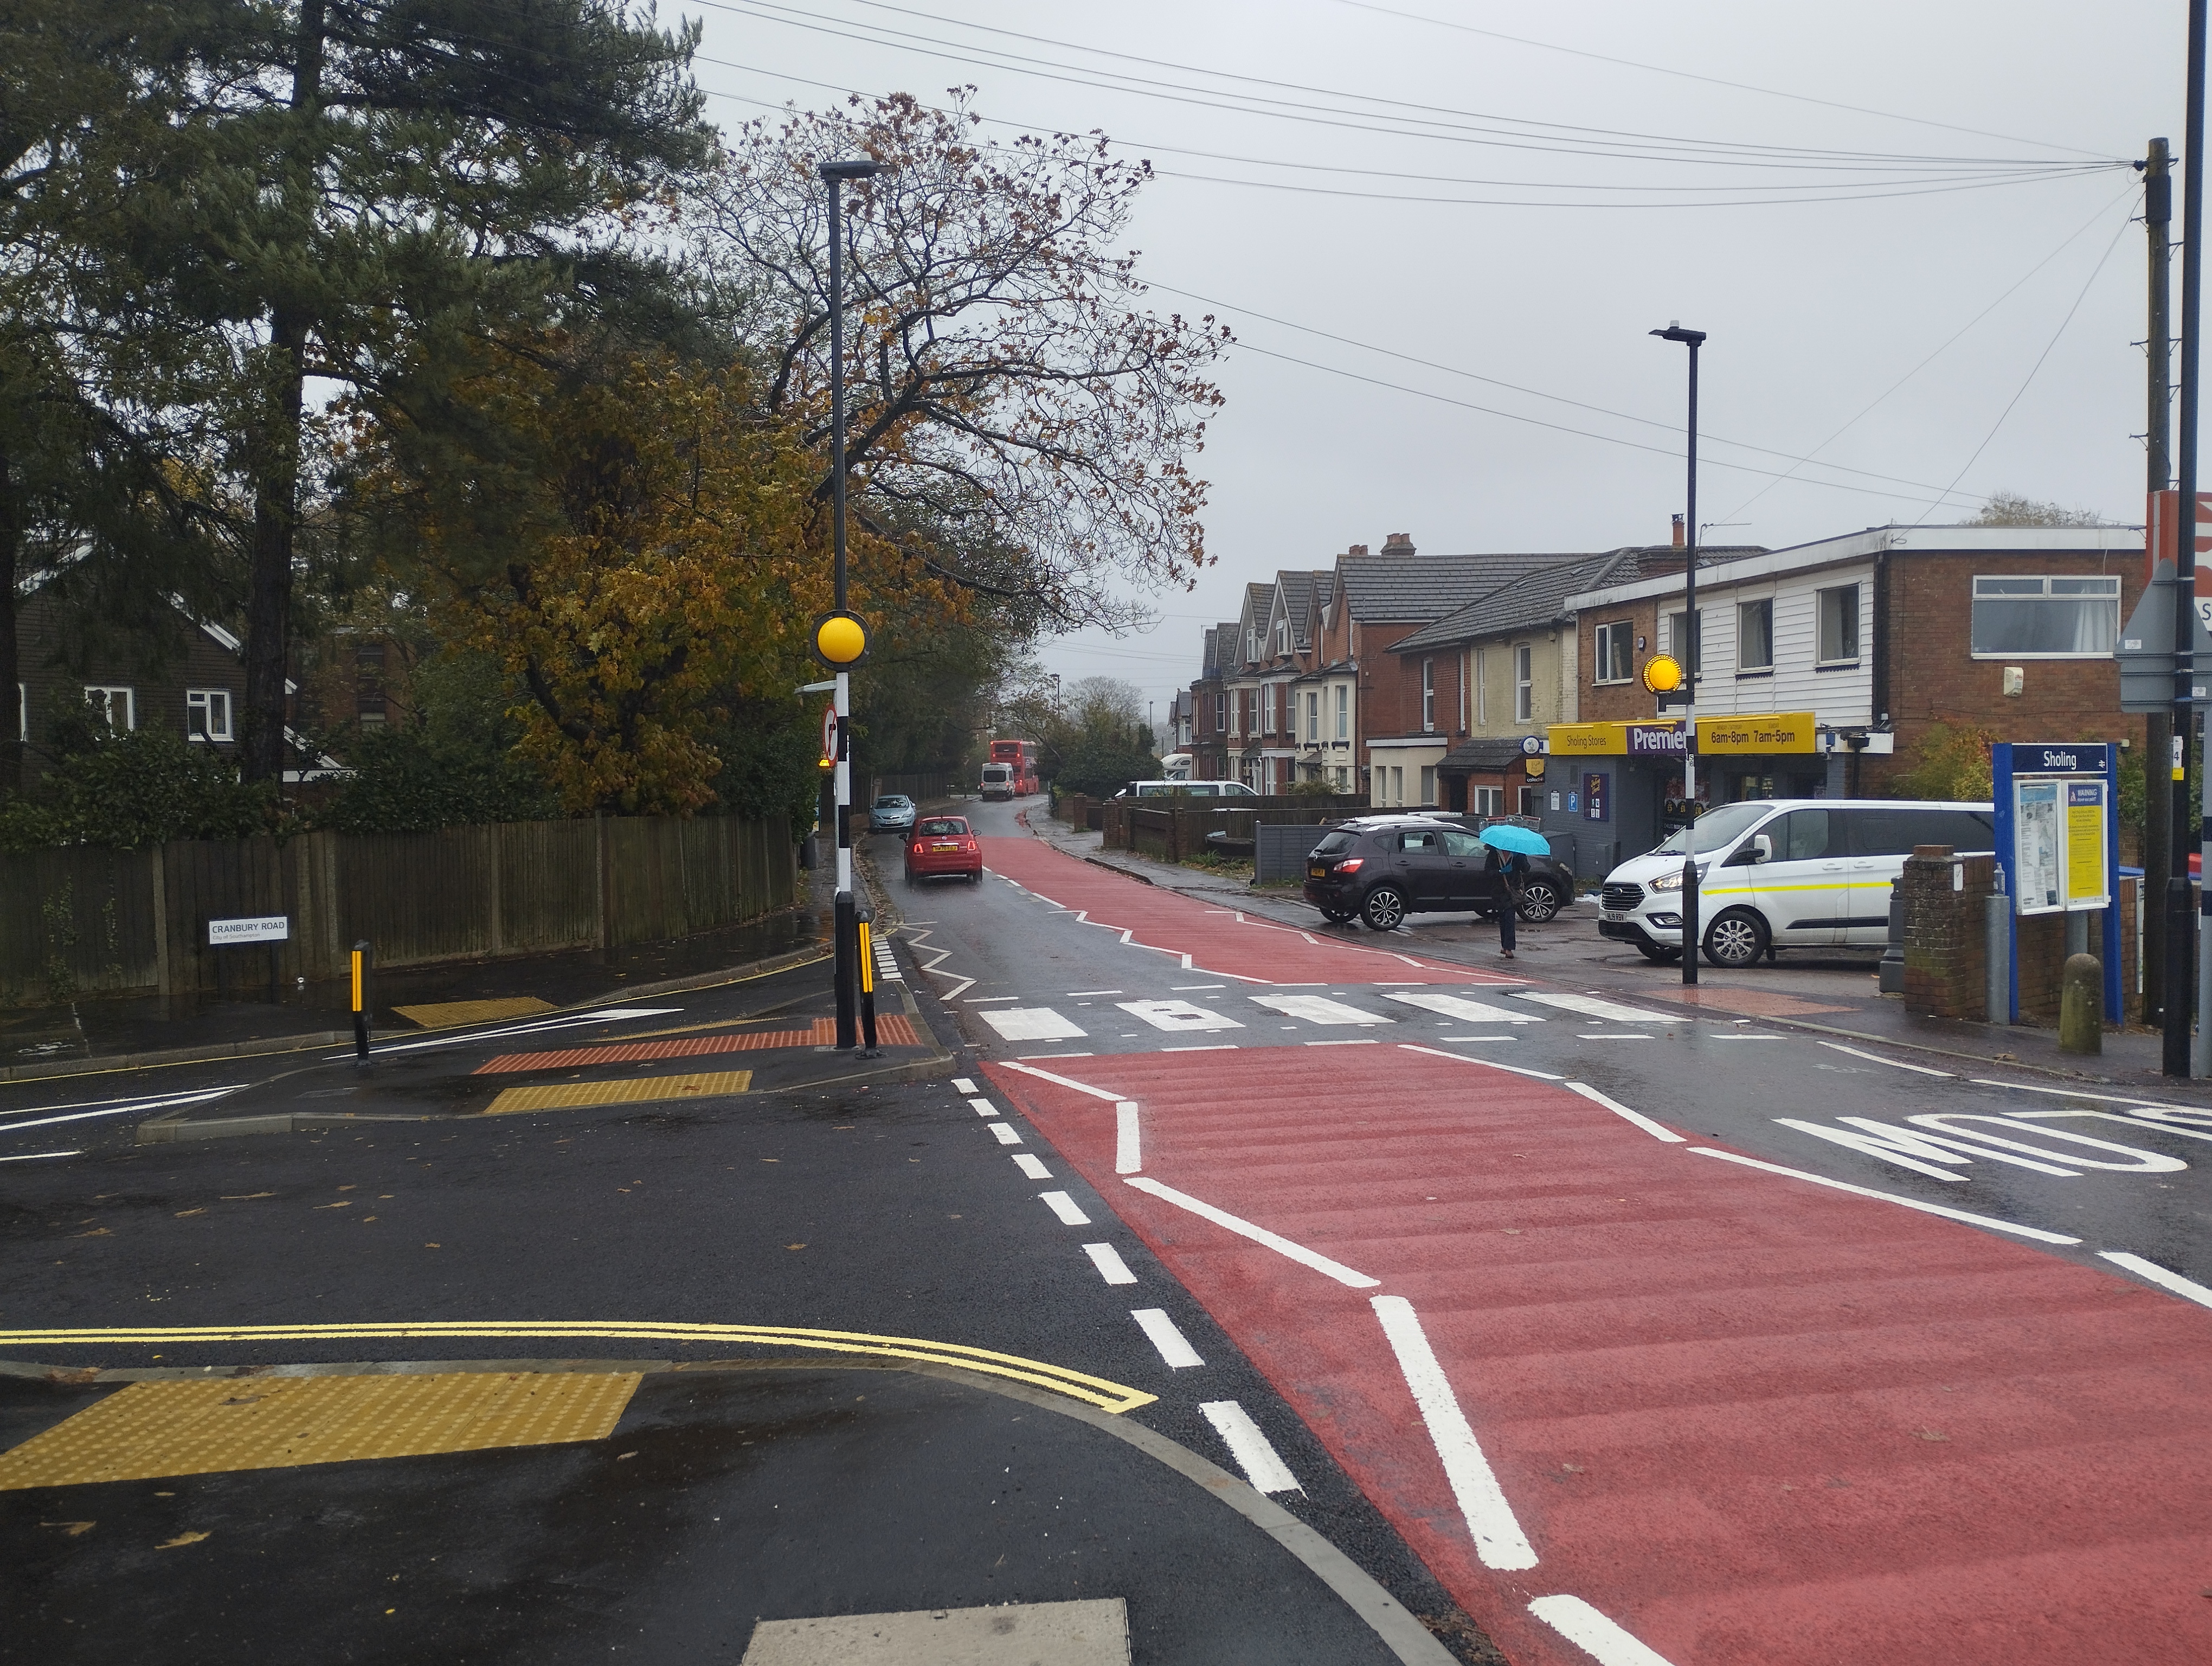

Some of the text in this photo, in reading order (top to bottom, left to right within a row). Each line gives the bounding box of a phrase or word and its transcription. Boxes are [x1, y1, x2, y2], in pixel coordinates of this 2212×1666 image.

[1566, 734, 1606, 749] Sholing Stores
[1634, 727, 1687, 750] Premier
[1711, 729, 1795, 745] 6am-8pm 7am-5pm
[2043, 751, 2076, 770] Sholing
[2174, 751, 2179, 760] 4
[1571, 796, 1575, 807] P
[213, 921, 285, 933] CRANBURY ROAD
